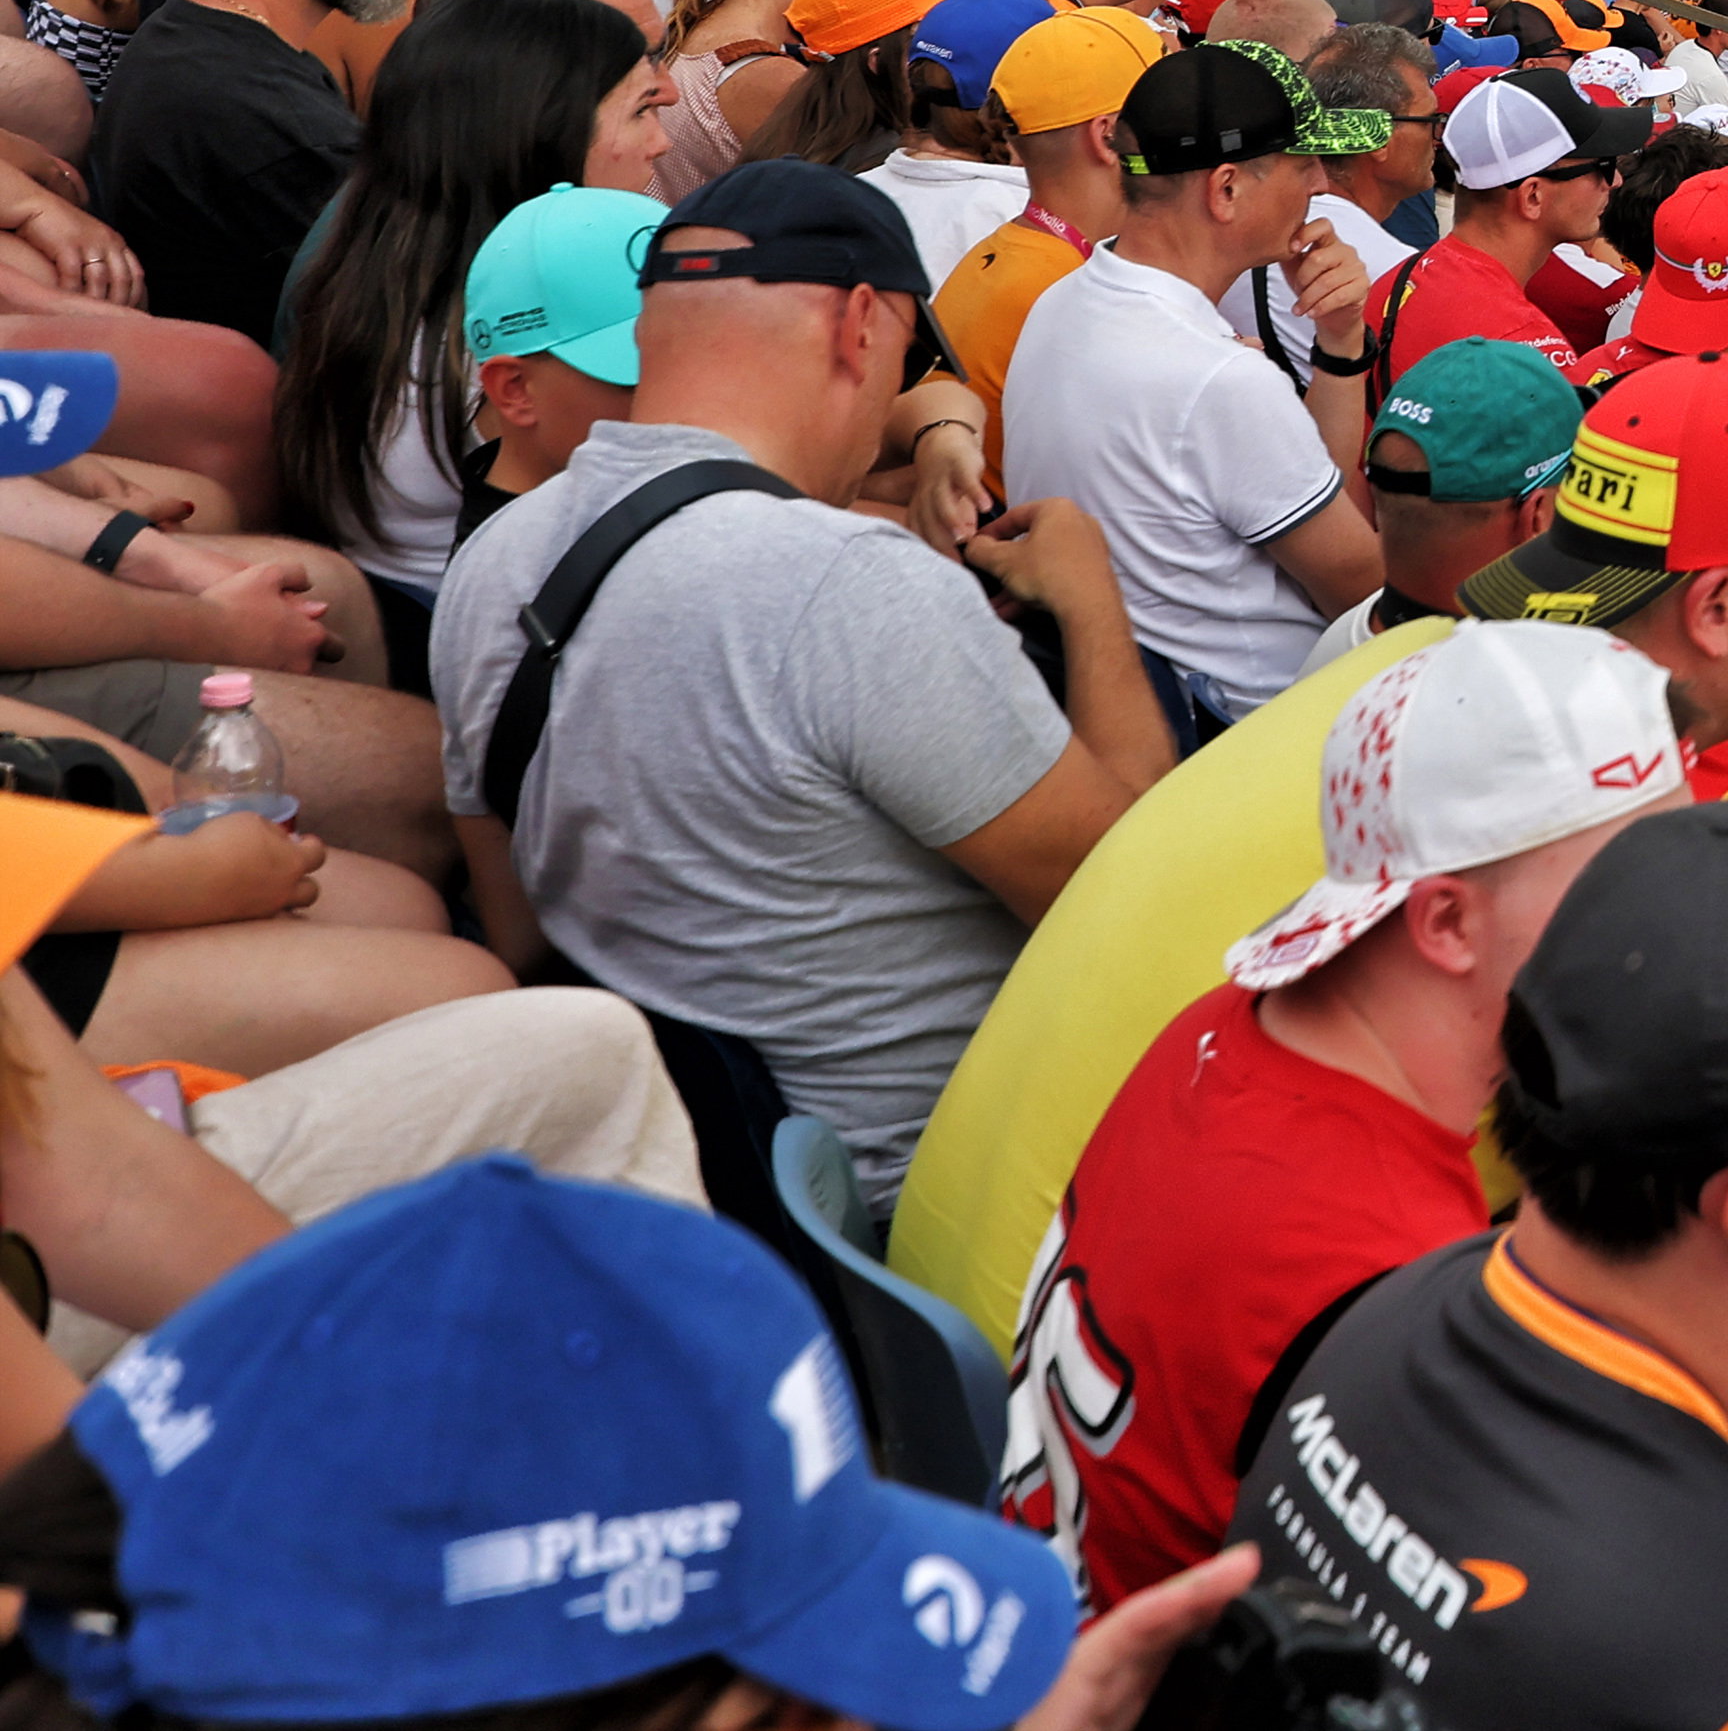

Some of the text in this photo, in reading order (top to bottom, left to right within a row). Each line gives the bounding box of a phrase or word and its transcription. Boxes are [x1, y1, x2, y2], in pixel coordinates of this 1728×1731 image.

[1388, 396, 1433, 425] BOSS
[538, 1500, 742, 1585] Player
[1288, 1392, 1468, 1634] McLaren
[1268, 1484, 1432, 1687] FORMULA TEAM
